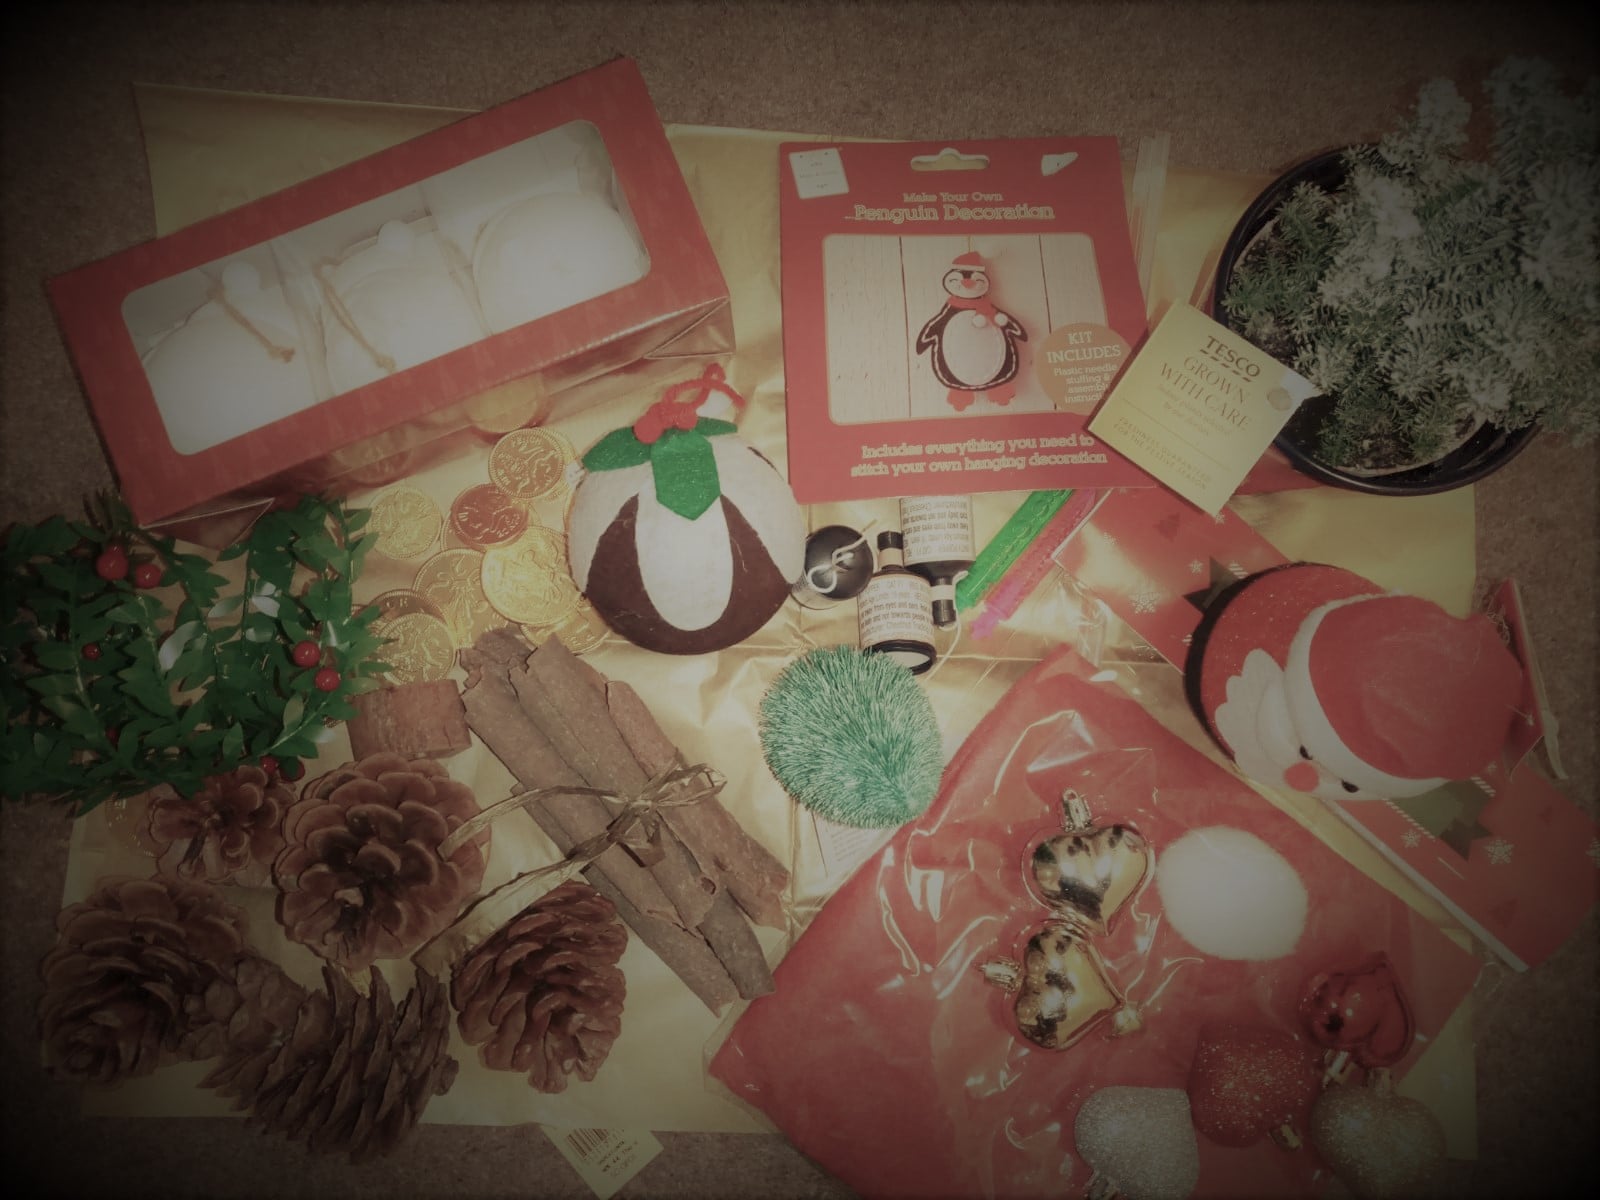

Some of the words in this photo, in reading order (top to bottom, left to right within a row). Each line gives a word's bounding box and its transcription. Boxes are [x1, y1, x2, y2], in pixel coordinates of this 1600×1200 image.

[903, 192, 937, 203] Make
[940, 192, 969, 203] Your
[972, 191, 1004, 202] Own
[854, 204, 939, 224] Penguin
[944, 203, 1055, 221] Decoration
[1067, 331, 1092, 345] KIT
[1046, 344, 1121, 363] INCLUDES
[1206, 335, 1261, 379] TESCO
[1053, 366, 1083, 377] Plastic
[1183, 355, 1248, 405] GROWN
[1160, 362, 1204, 401] WITH
[1204, 393, 1250, 427] CARE
[925, 438, 1005, 456] everything
[1008, 437, 1036, 452] you
[1040, 434, 1077, 448] need
[1080, 434, 1094, 447] to
[851, 461, 889, 477] stitch
[892, 461, 925, 477] your
[929, 460, 961, 472] own
[964, 454, 1026, 472] hanging
[1029, 451, 1108, 466] decoration
